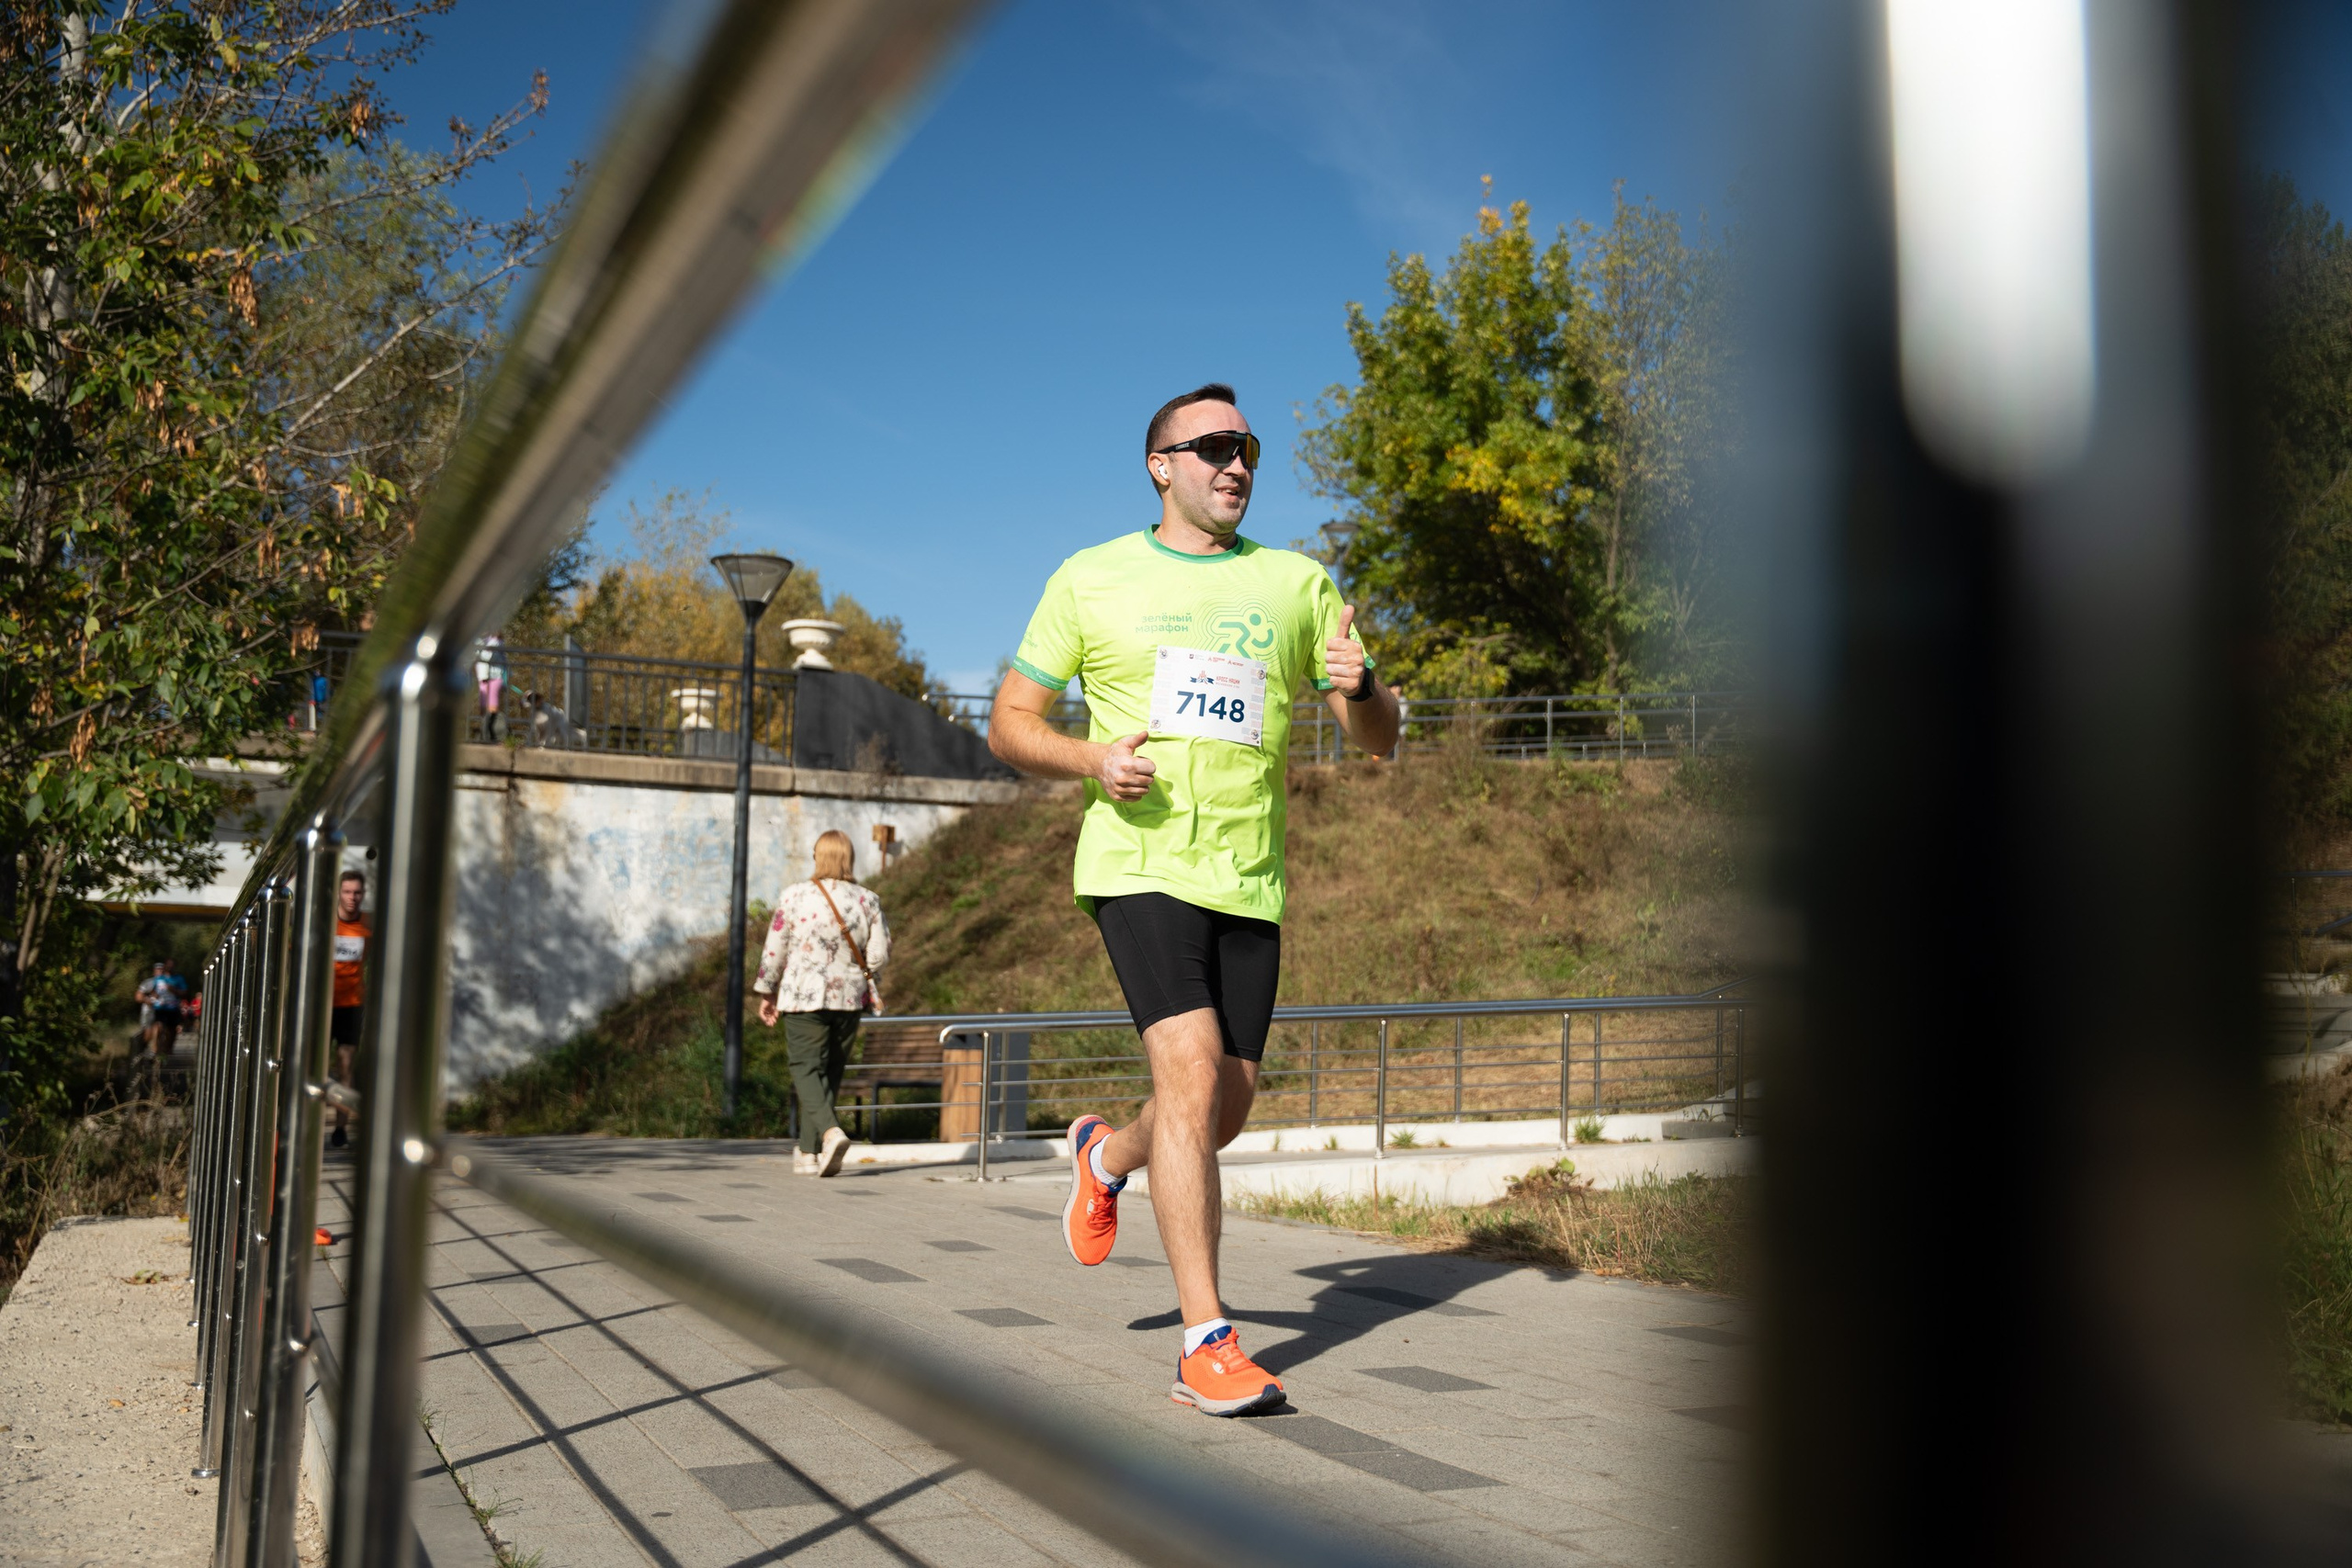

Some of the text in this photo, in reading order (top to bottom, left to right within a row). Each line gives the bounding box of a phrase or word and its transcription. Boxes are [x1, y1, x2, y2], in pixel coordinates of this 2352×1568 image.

[1142, 613, 1193, 623] зелёный
[1136, 623, 1189, 634] марафон
[1176, 691, 1245, 723] 7148
